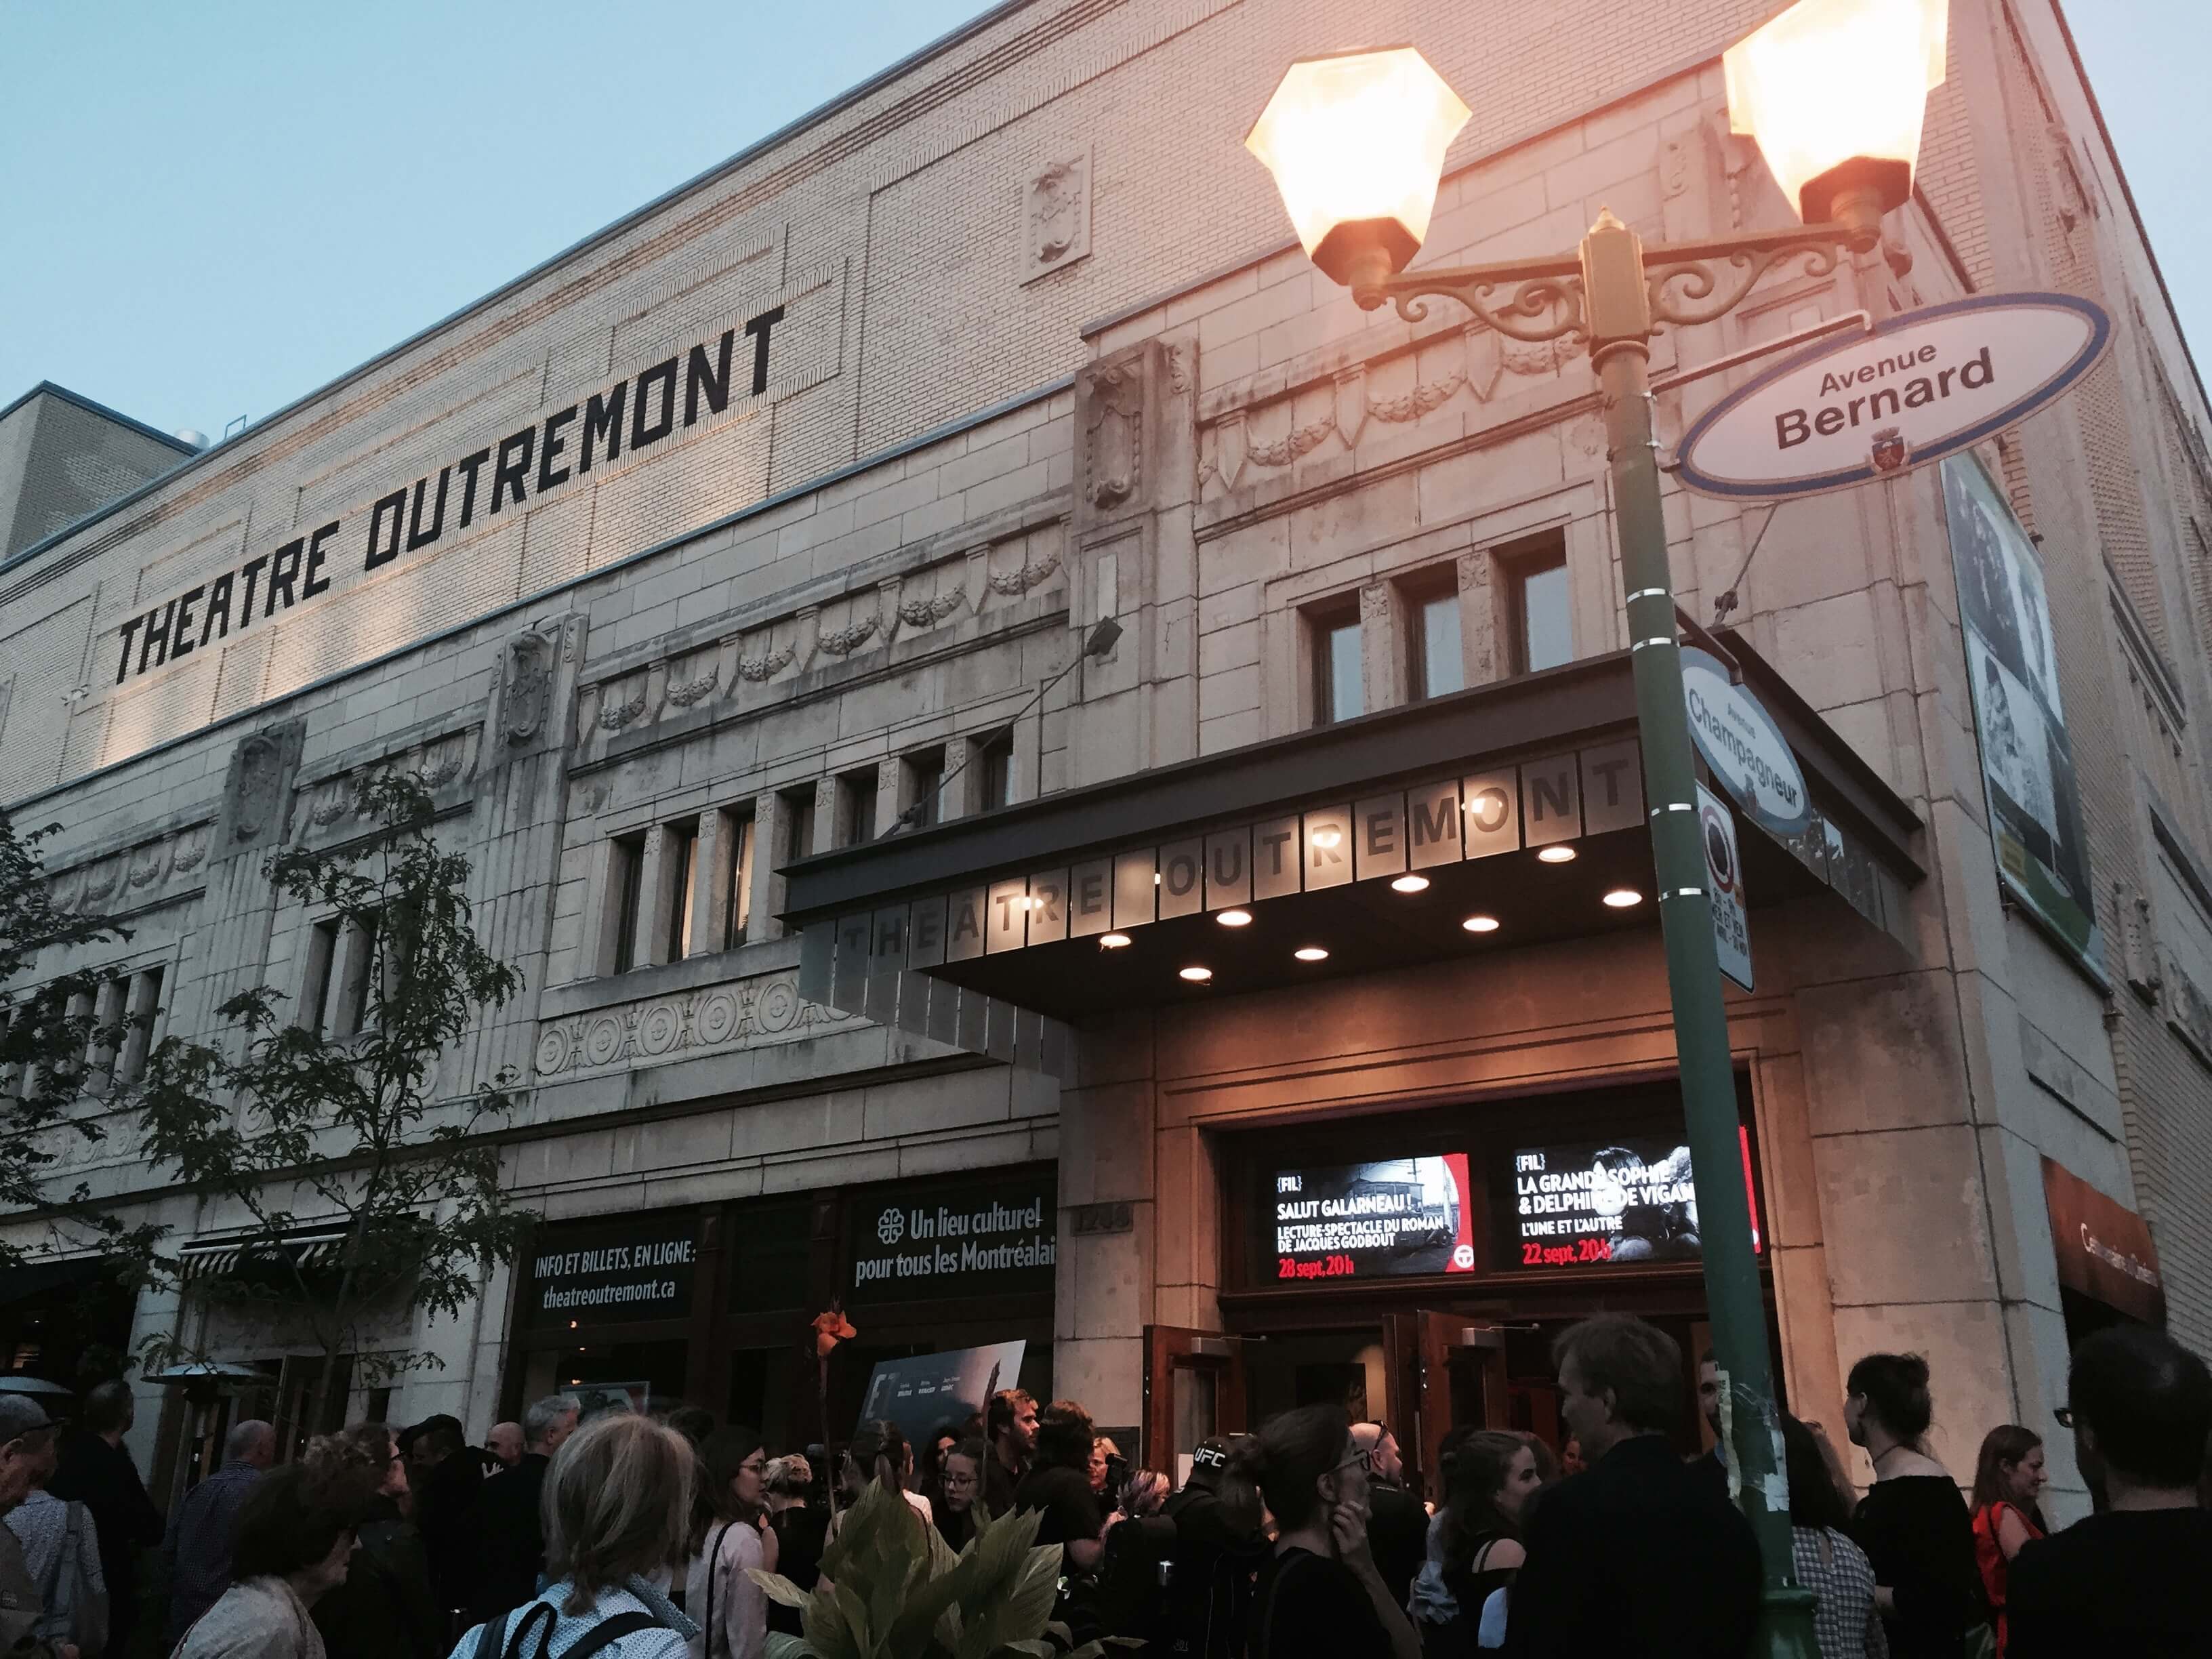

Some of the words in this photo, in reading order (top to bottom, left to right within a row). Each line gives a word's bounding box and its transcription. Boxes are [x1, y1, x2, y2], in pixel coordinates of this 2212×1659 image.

[1818, 344, 1938, 398] Avenue
[1774, 346, 1995, 450] Bernard
[117, 520, 340, 685] THEATRE
[364, 305, 785, 571] OUTREMONT
[1689, 688, 1797, 808] Champagneur
[1166, 758, 1630, 897] OUTREMONT
[1516, 1153, 1546, 1172] {FIL}
[1277, 1175, 1303, 1193] {FIL}
[1517, 1176, 1538, 1195] LA
[1538, 1169, 1607, 1193] GRAND
[1607, 1164, 1671, 1187] SOPHIE
[1277, 1200, 1319, 1221] SALUT
[1321, 1193, 1404, 1217] GALARNEAU
[1518, 1197, 1532, 1215] &
[1616, 1187, 1639, 1206] DE
[910, 1208, 934, 1240] Un
[937, 1206, 969, 1237] lieu
[972, 1197, 1041, 1234] culturel
[1277, 1220, 1383, 1240] LECTURE-SPECTACLE
[1384, 1218, 1400, 1232] DU
[1401, 1216, 1444, 1232] ROMAN
[1521, 1221, 1555, 1237] L'UNE
[1557, 1219, 1573, 1233] ET
[1574, 1216, 1624, 1233] L'AUTRE
[1277, 1238, 1292, 1253] DE
[1293, 1235, 1340, 1252] JACQUES
[1340, 1232, 1396, 1249] GODBOUT
[1522, 1242, 1543, 1265] 22
[535, 1254, 563, 1278] INFO
[564, 1252, 581, 1275] ET
[581, 1247, 631, 1273] BILLETS,
[634, 1244, 652, 1268] EN
[653, 1240, 697, 1265] LIGNE:
[855, 1257, 894, 1288] pour
[896, 1253, 932, 1277] tous
[935, 1244, 958, 1275] les
[1278, 1257, 1296, 1278] 28
[543, 1279, 676, 1310] theatreoutremont.ca
[1194, 1446, 1226, 1468] UFC
